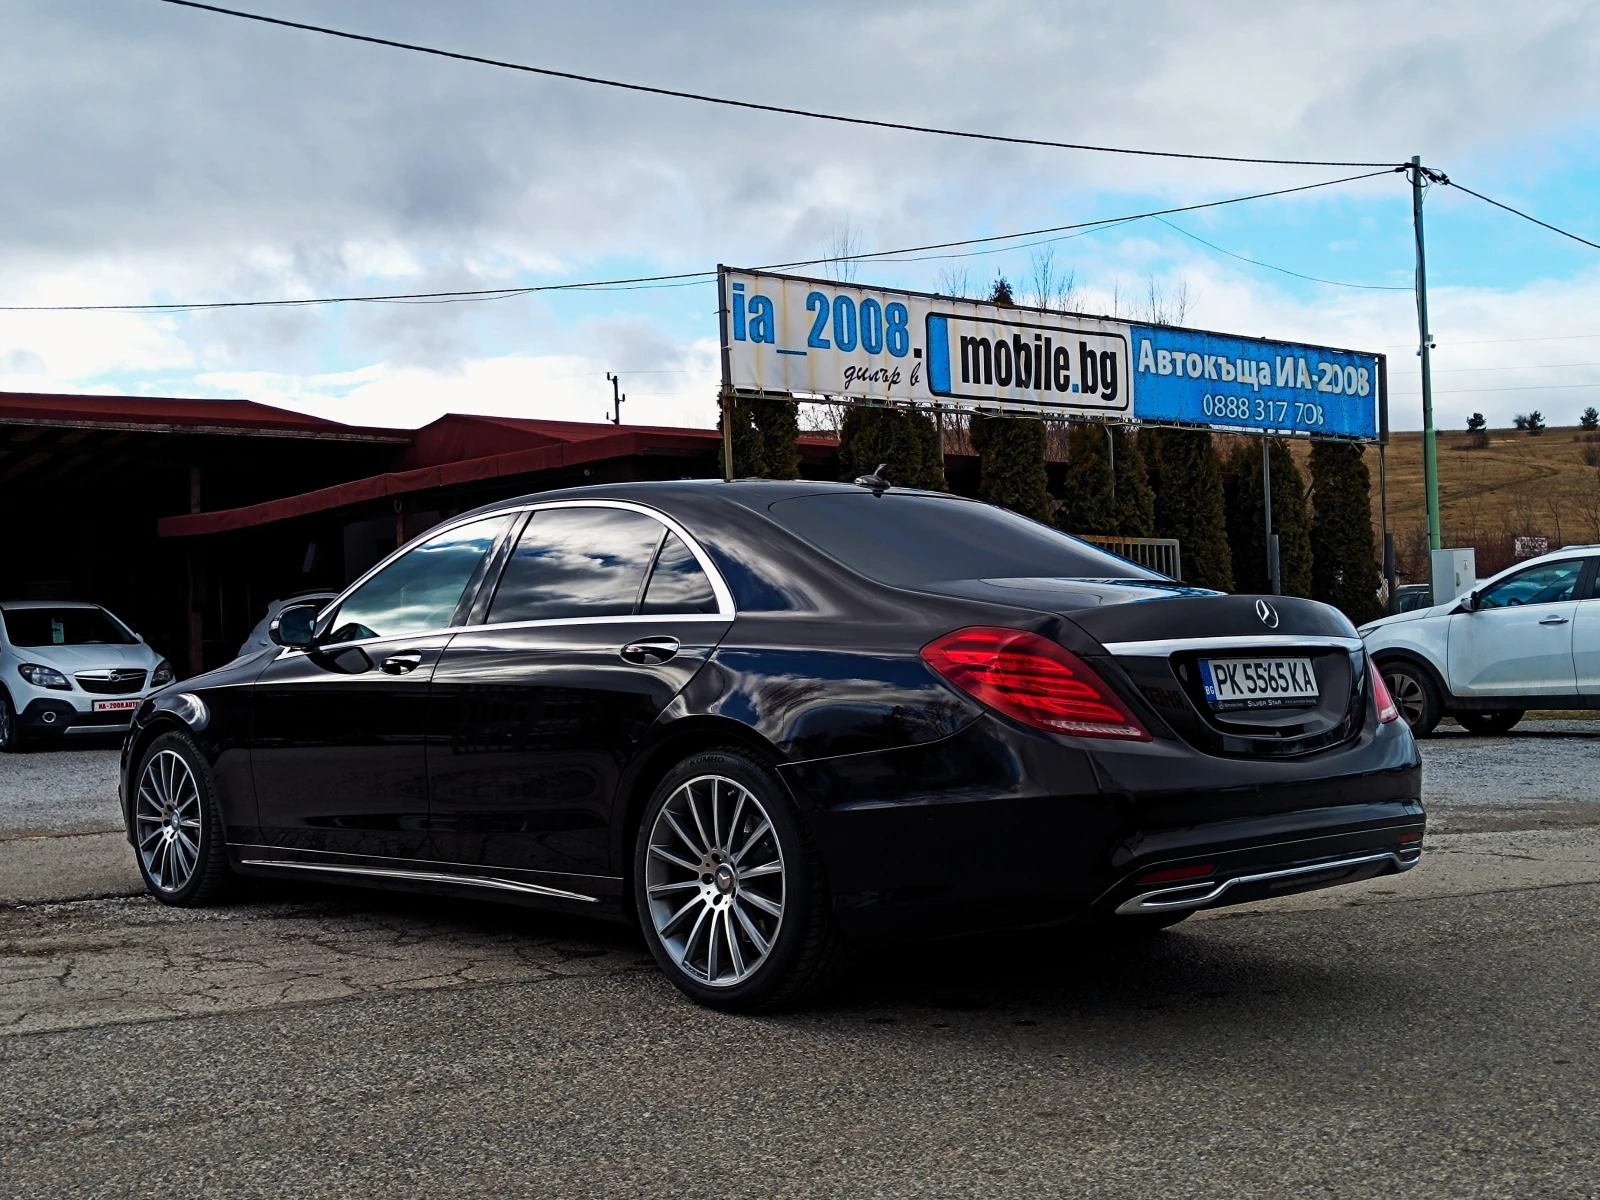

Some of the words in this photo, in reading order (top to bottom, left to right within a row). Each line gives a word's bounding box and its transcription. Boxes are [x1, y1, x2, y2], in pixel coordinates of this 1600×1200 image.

[844, 365, 901, 390] дилър
[960, 333, 1118, 401] mobile.bg
[1138, 339, 1271, 391] Автокъща
[1275, 356, 1370, 397] ИА-2008
[1203, 394, 1249, 420] 0888
[1254, 399, 1288, 422] 317
[1204, 685, 1215, 695] BG
[690, 755, 725, 767] KUMHO
